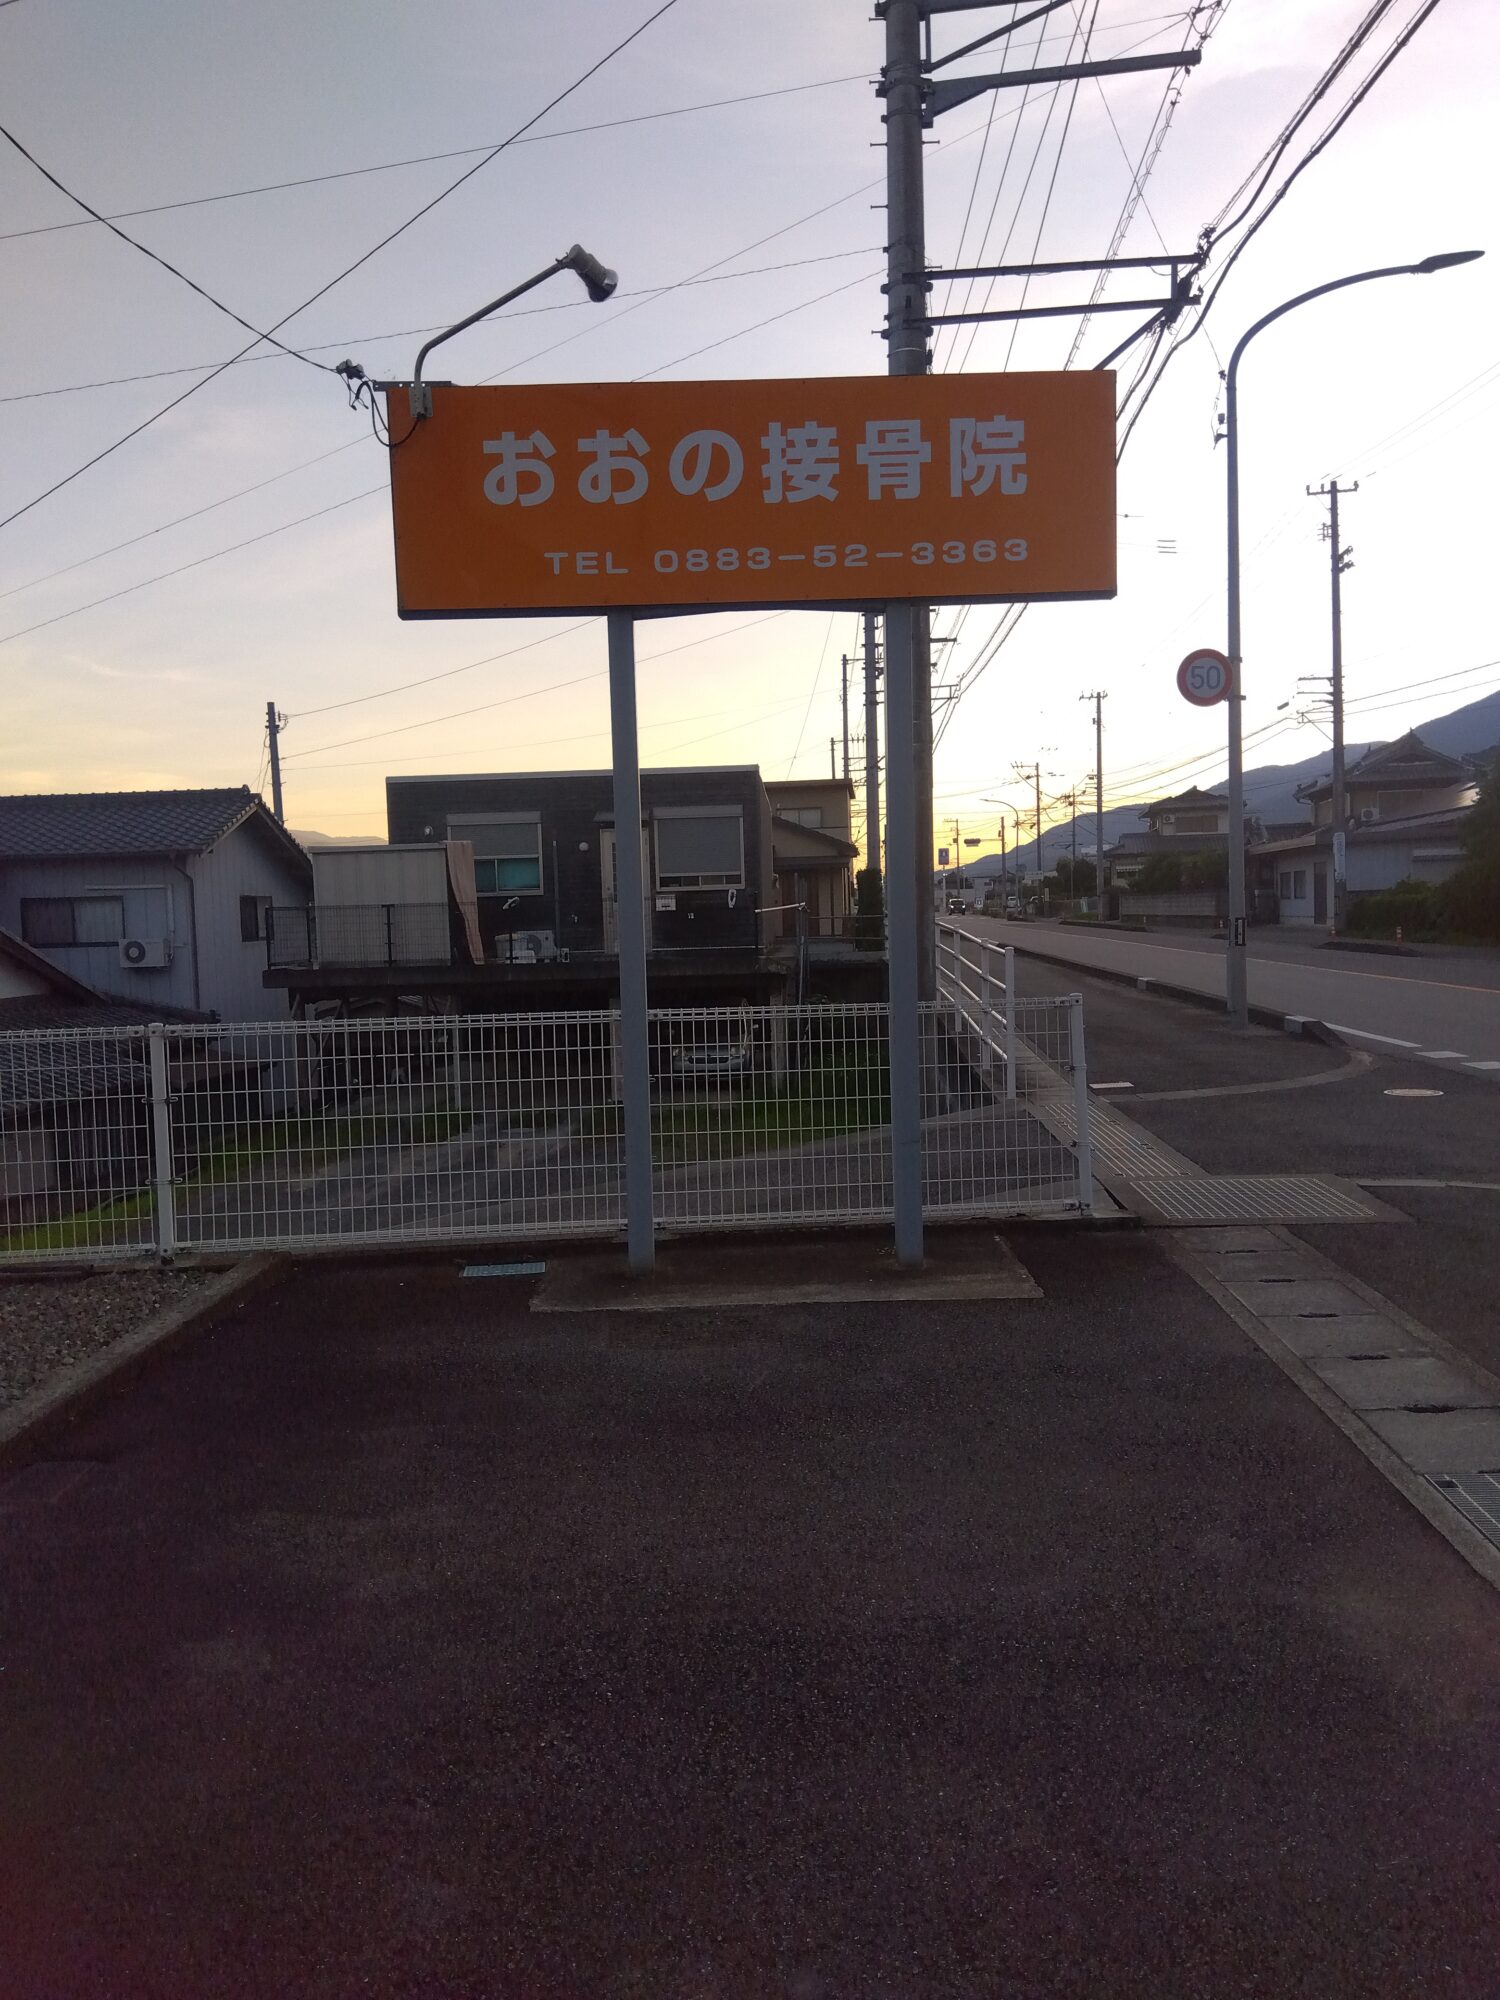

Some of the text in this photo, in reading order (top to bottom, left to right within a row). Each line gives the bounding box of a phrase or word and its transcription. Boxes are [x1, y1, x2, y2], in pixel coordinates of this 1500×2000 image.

[482, 414, 1029, 507] おおの接骨院
[543, 539, 1029, 575] TEL 0883-52-3363
[1190, 665, 1221, 690] 50
